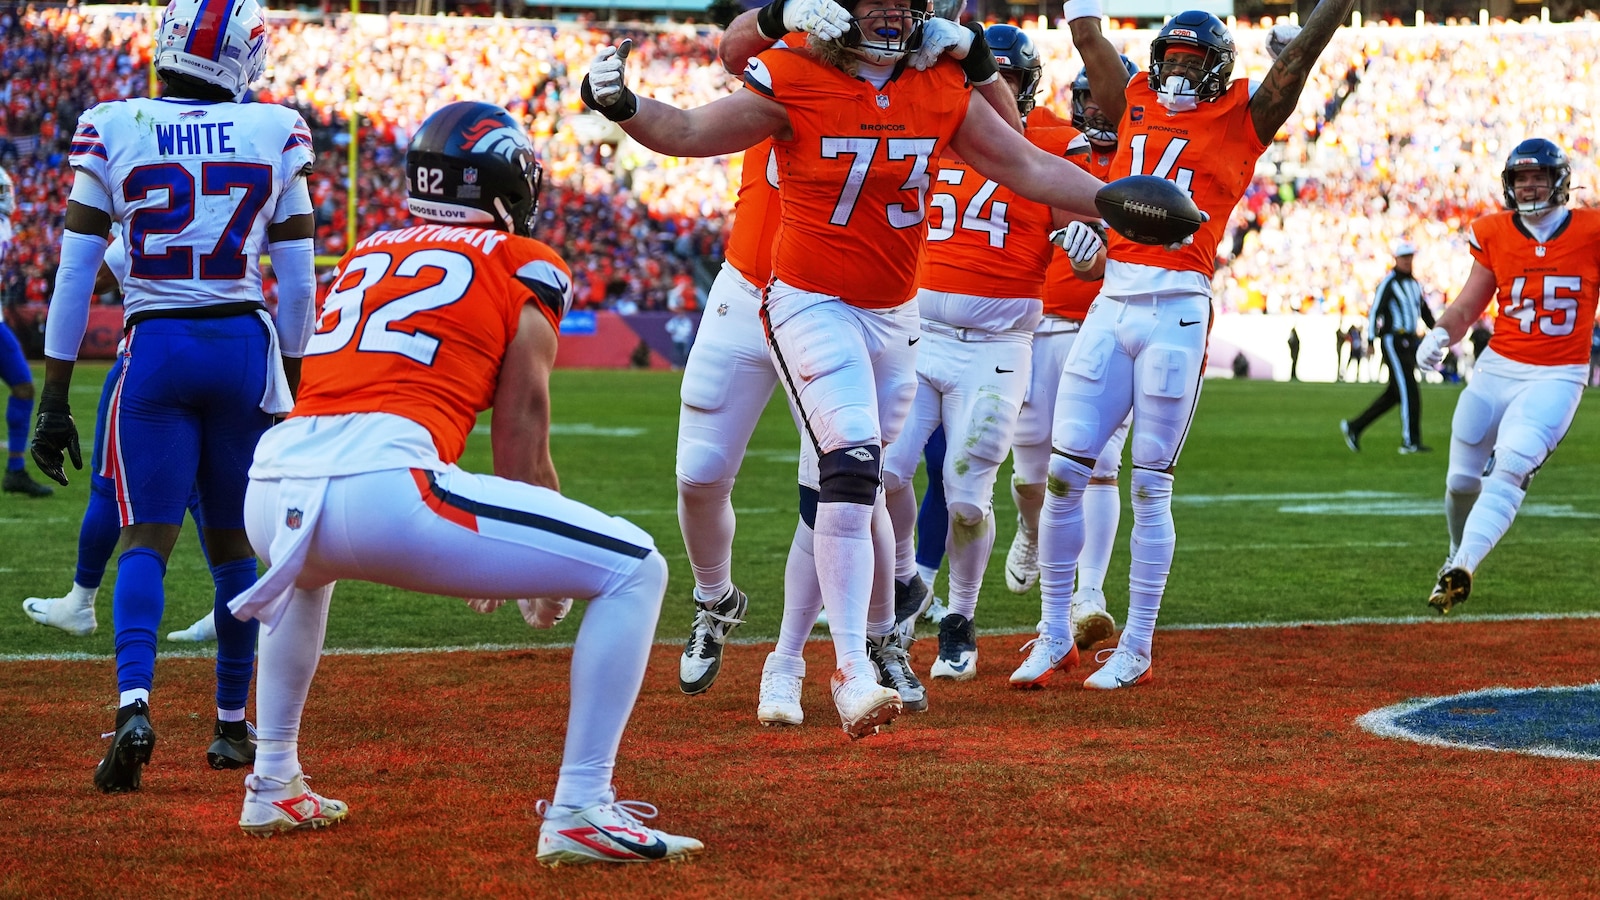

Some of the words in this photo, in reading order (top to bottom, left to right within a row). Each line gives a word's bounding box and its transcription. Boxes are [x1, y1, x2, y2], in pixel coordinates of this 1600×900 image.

[180, 58, 201, 68] CHOOSE
[201, 64, 215, 72] LOVE
[1130, 106, 1144, 121] C
[1147, 125, 1189, 135] BRONCOS
[156, 122, 236, 155] WHITE
[416, 166, 444, 195] 82
[820, 136, 939, 230] 73
[1129, 134, 1195, 199] 14
[123, 162, 272, 280] 27
[409, 204, 438, 216] CHOOSE
[439, 210, 466, 218] LOVE
[926, 168, 1010, 249] 54
[355, 224, 508, 256] RAUTMAN
[302, 248, 475, 367] 82
[1503, 274, 1582, 336] 45
